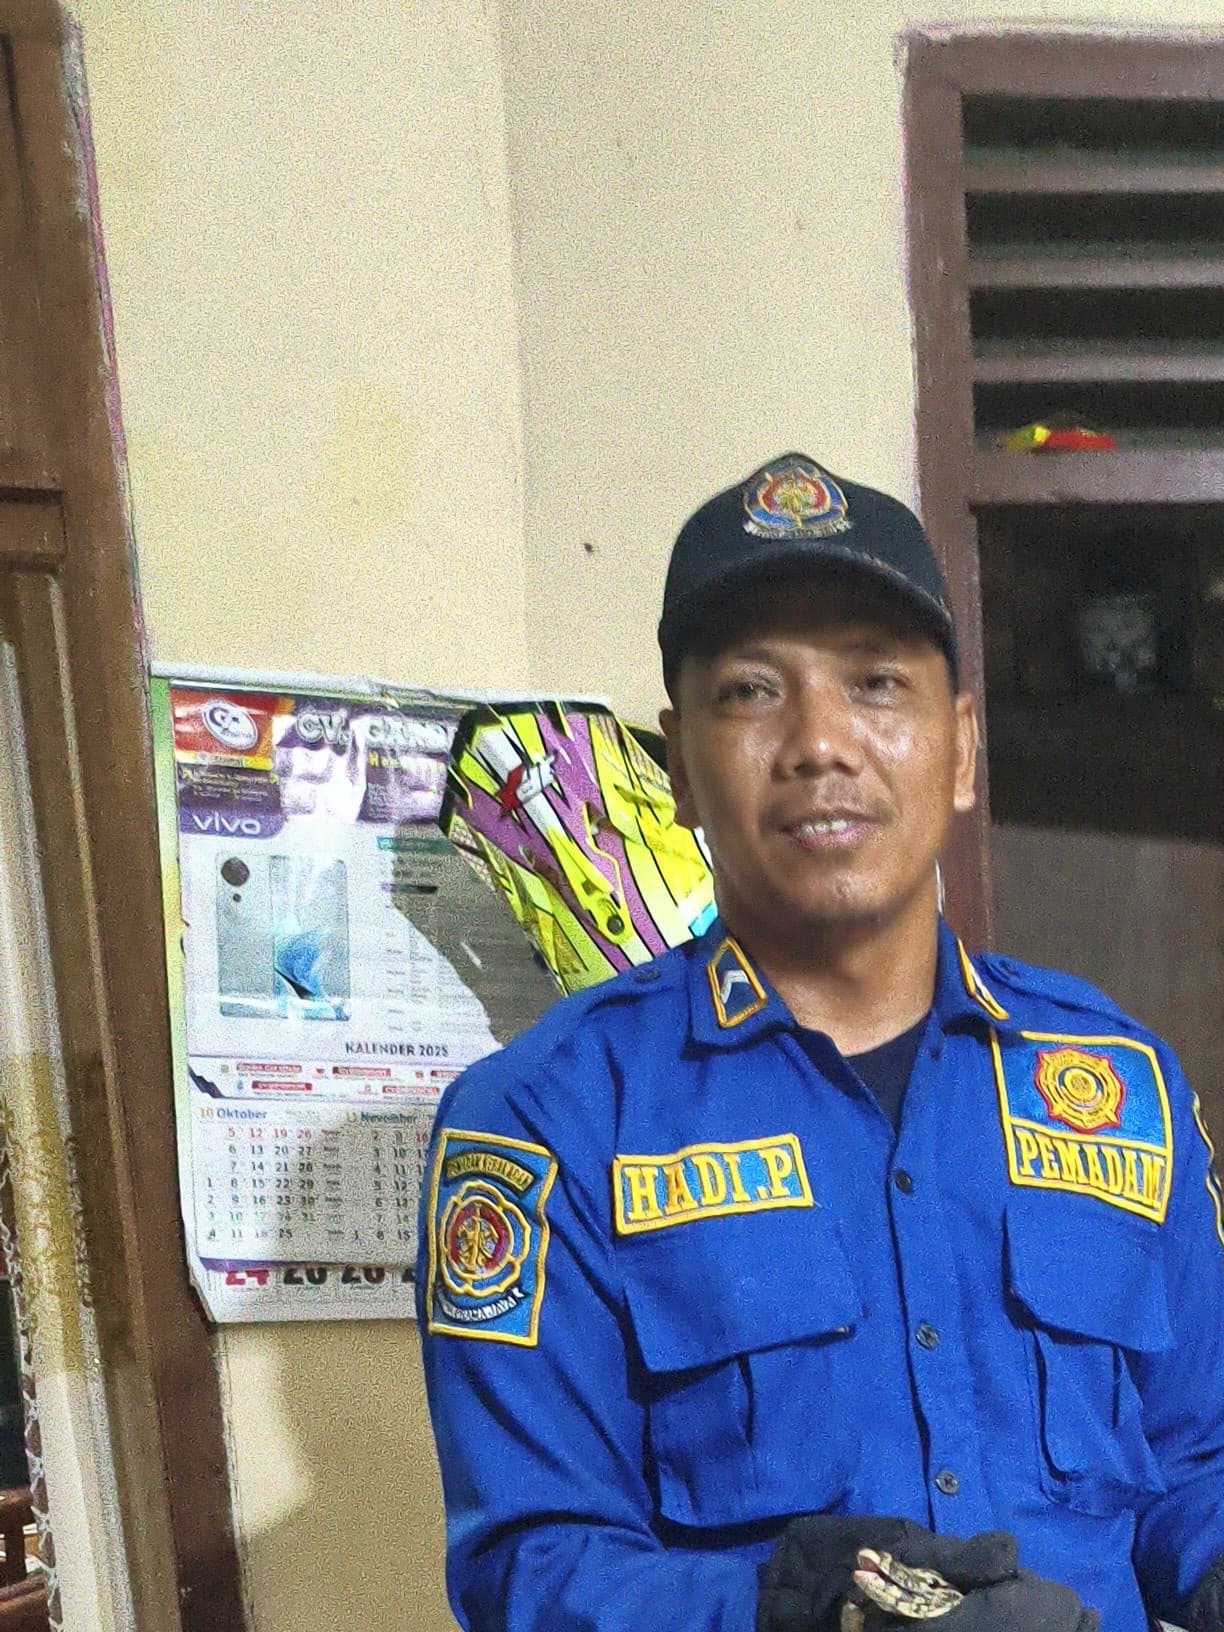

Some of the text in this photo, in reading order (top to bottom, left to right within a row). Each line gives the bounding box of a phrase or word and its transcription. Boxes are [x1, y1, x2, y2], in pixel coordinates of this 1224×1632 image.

[192, 812, 261, 834] vivo
[345, 1041, 449, 1058] KALENDER 2025
[216, 1107, 267, 1120] Oktober
[250, 1128, 263, 1138] 12
[275, 1145, 289, 1155] 20
[252, 1161, 264, 1171] 14
[275, 1162, 288, 1172] 21
[1014, 1127, 1166, 1210] PEMADAM
